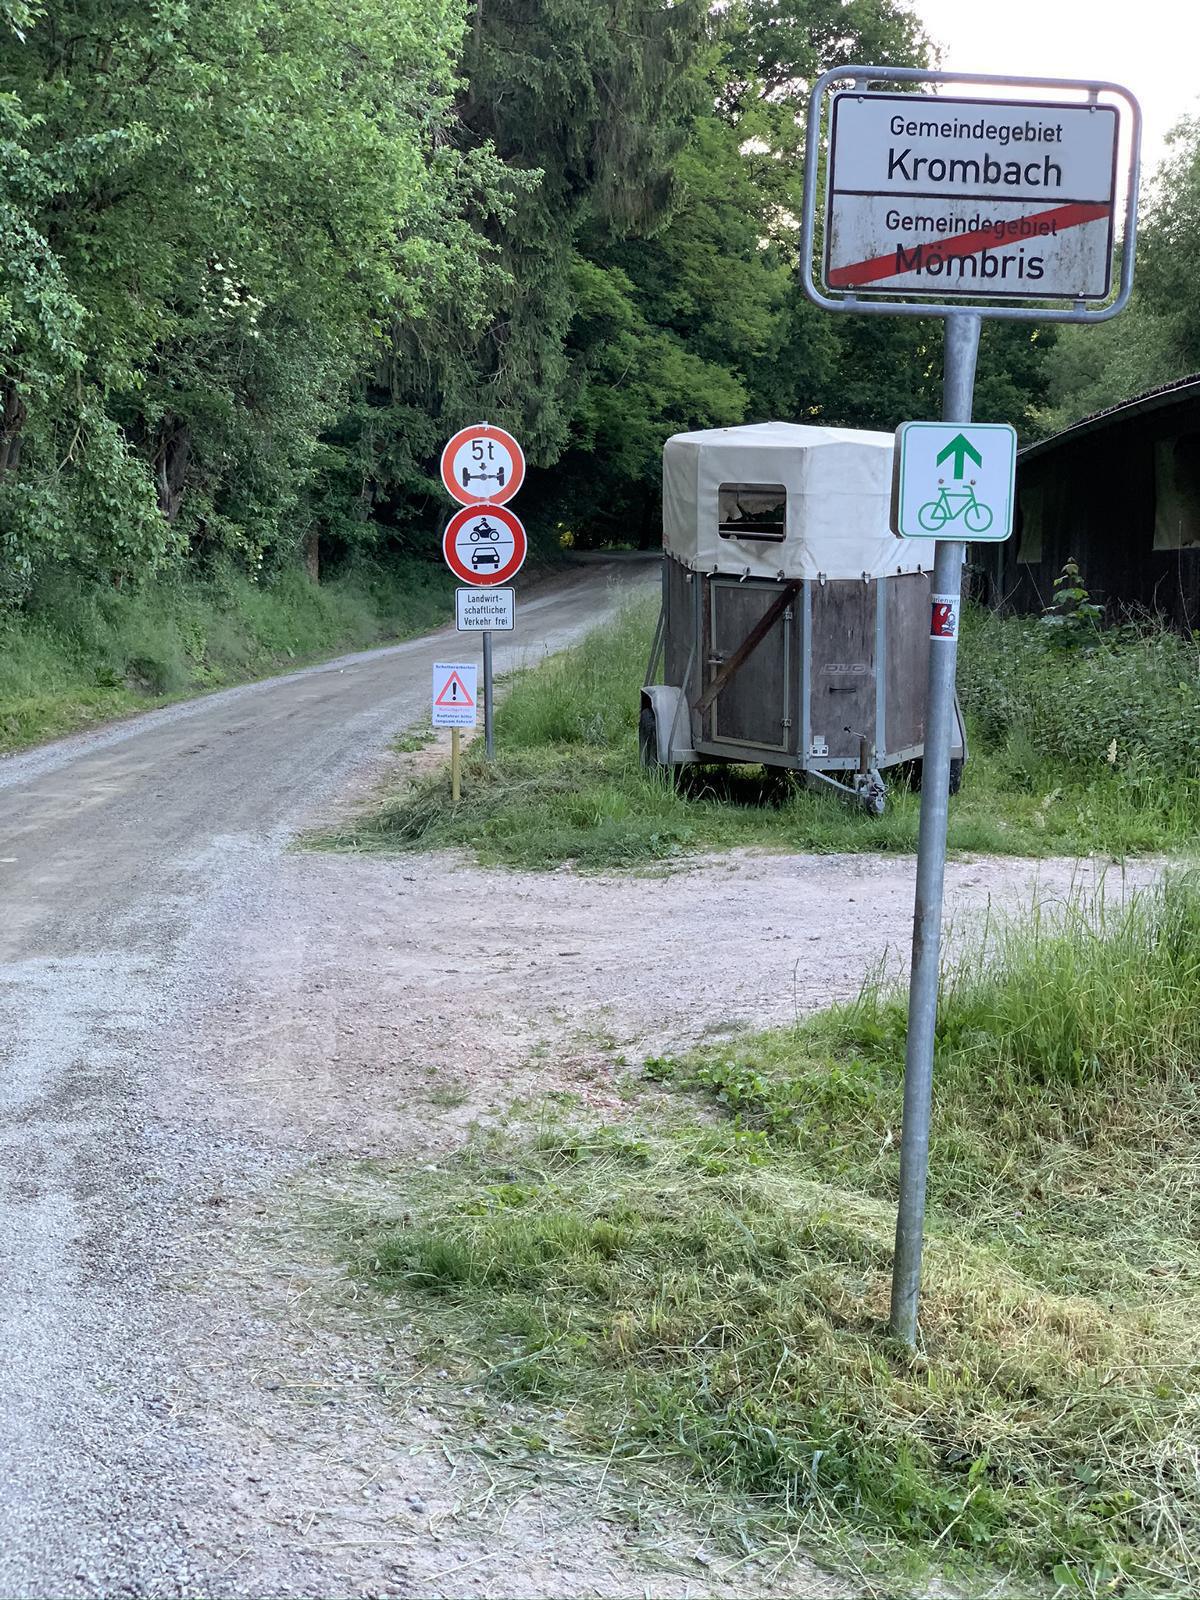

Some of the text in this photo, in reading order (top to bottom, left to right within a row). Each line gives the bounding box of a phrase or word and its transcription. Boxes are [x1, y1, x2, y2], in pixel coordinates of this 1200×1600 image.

[890, 116, 1063, 145] Gemeindegebiet
[887, 148, 1062, 187] Krombach
[885, 210, 1058, 239] Gemeindegebiet
[894, 243, 1045, 279] Mömbris
[464, 605, 507, 614] schaftlicher
[467, 594, 503, 603] Landwirt-
[464, 616, 508, 626] Verkehr frei
